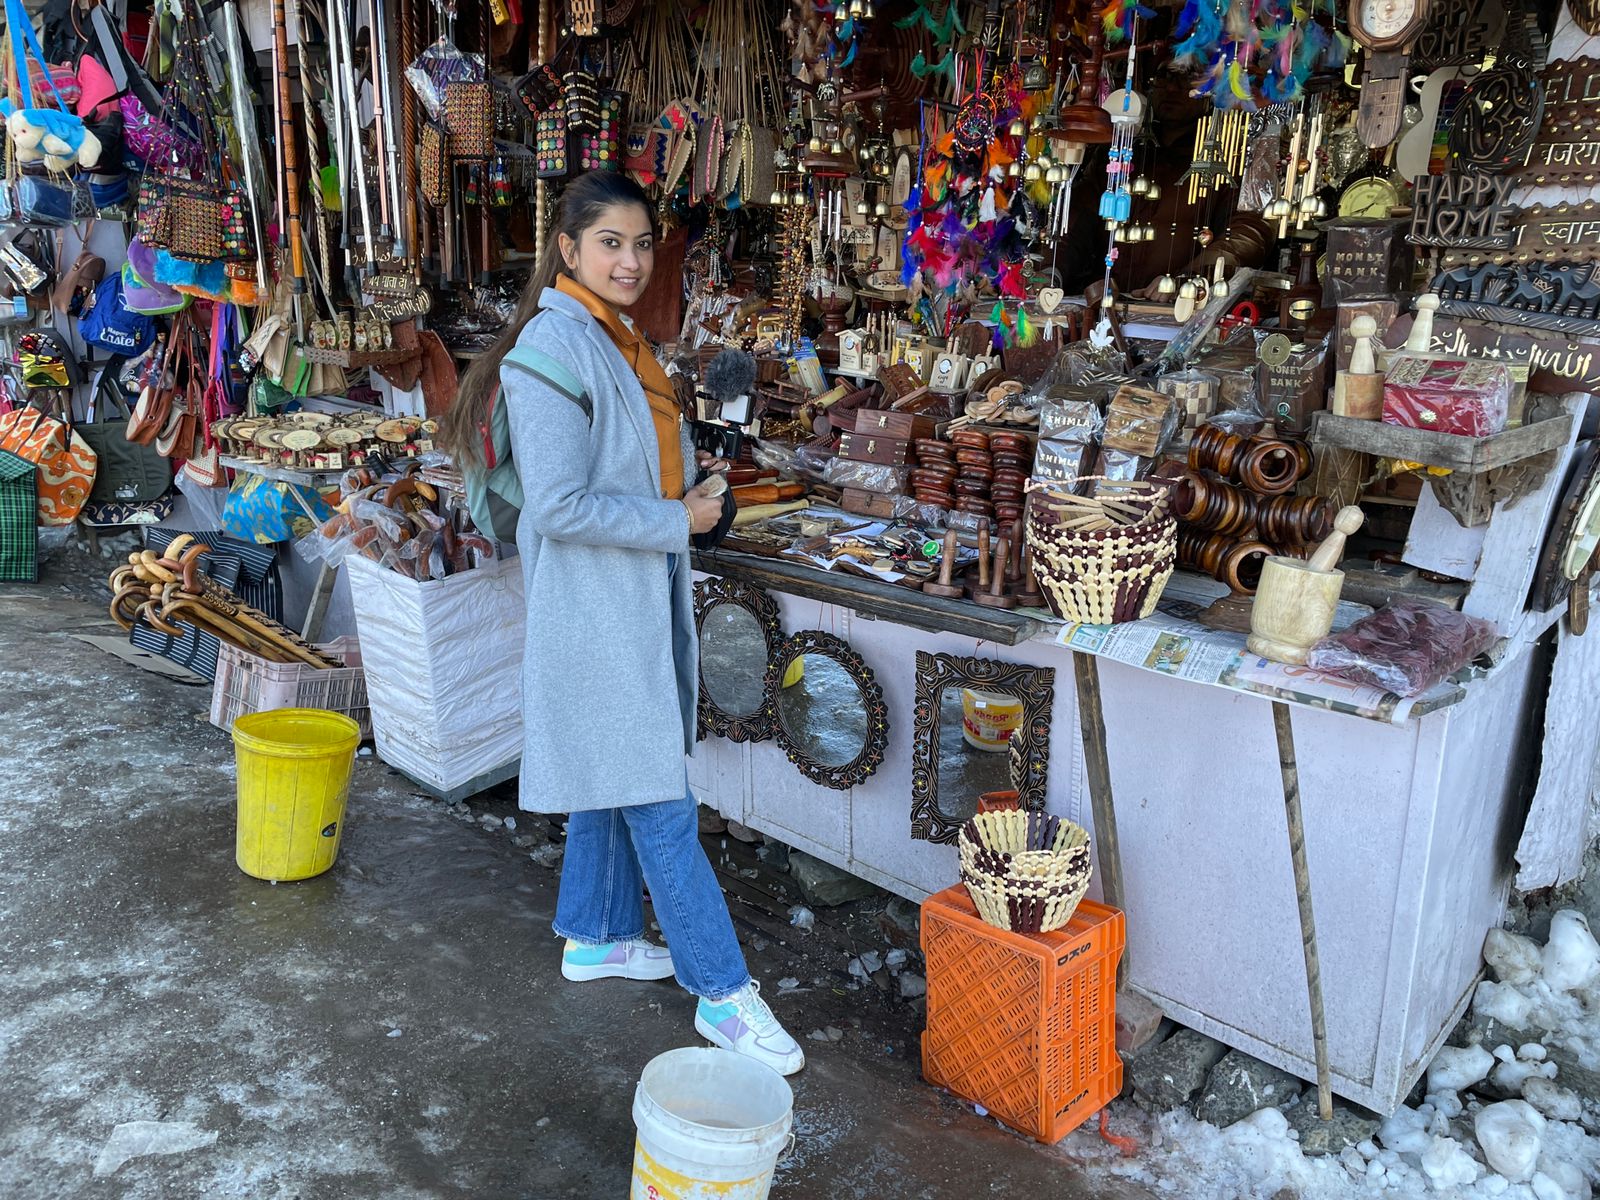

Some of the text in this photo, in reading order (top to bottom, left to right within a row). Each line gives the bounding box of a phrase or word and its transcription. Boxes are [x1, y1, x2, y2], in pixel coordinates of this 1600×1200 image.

[1414, 174, 1512, 205] HAPPY
[1411, 203, 1513, 239] HOME
[1335, 252, 1385, 262] MONEY
[1333, 266, 1379, 276] BANK
[107, 326, 129, 338] Happy
[1270, 377, 1302, 389] BANK
[1046, 413, 1091, 428] SHIMLA
[1039, 453, 1079, 467] SHIMLA
[1036, 465, 1073, 479] BANK
